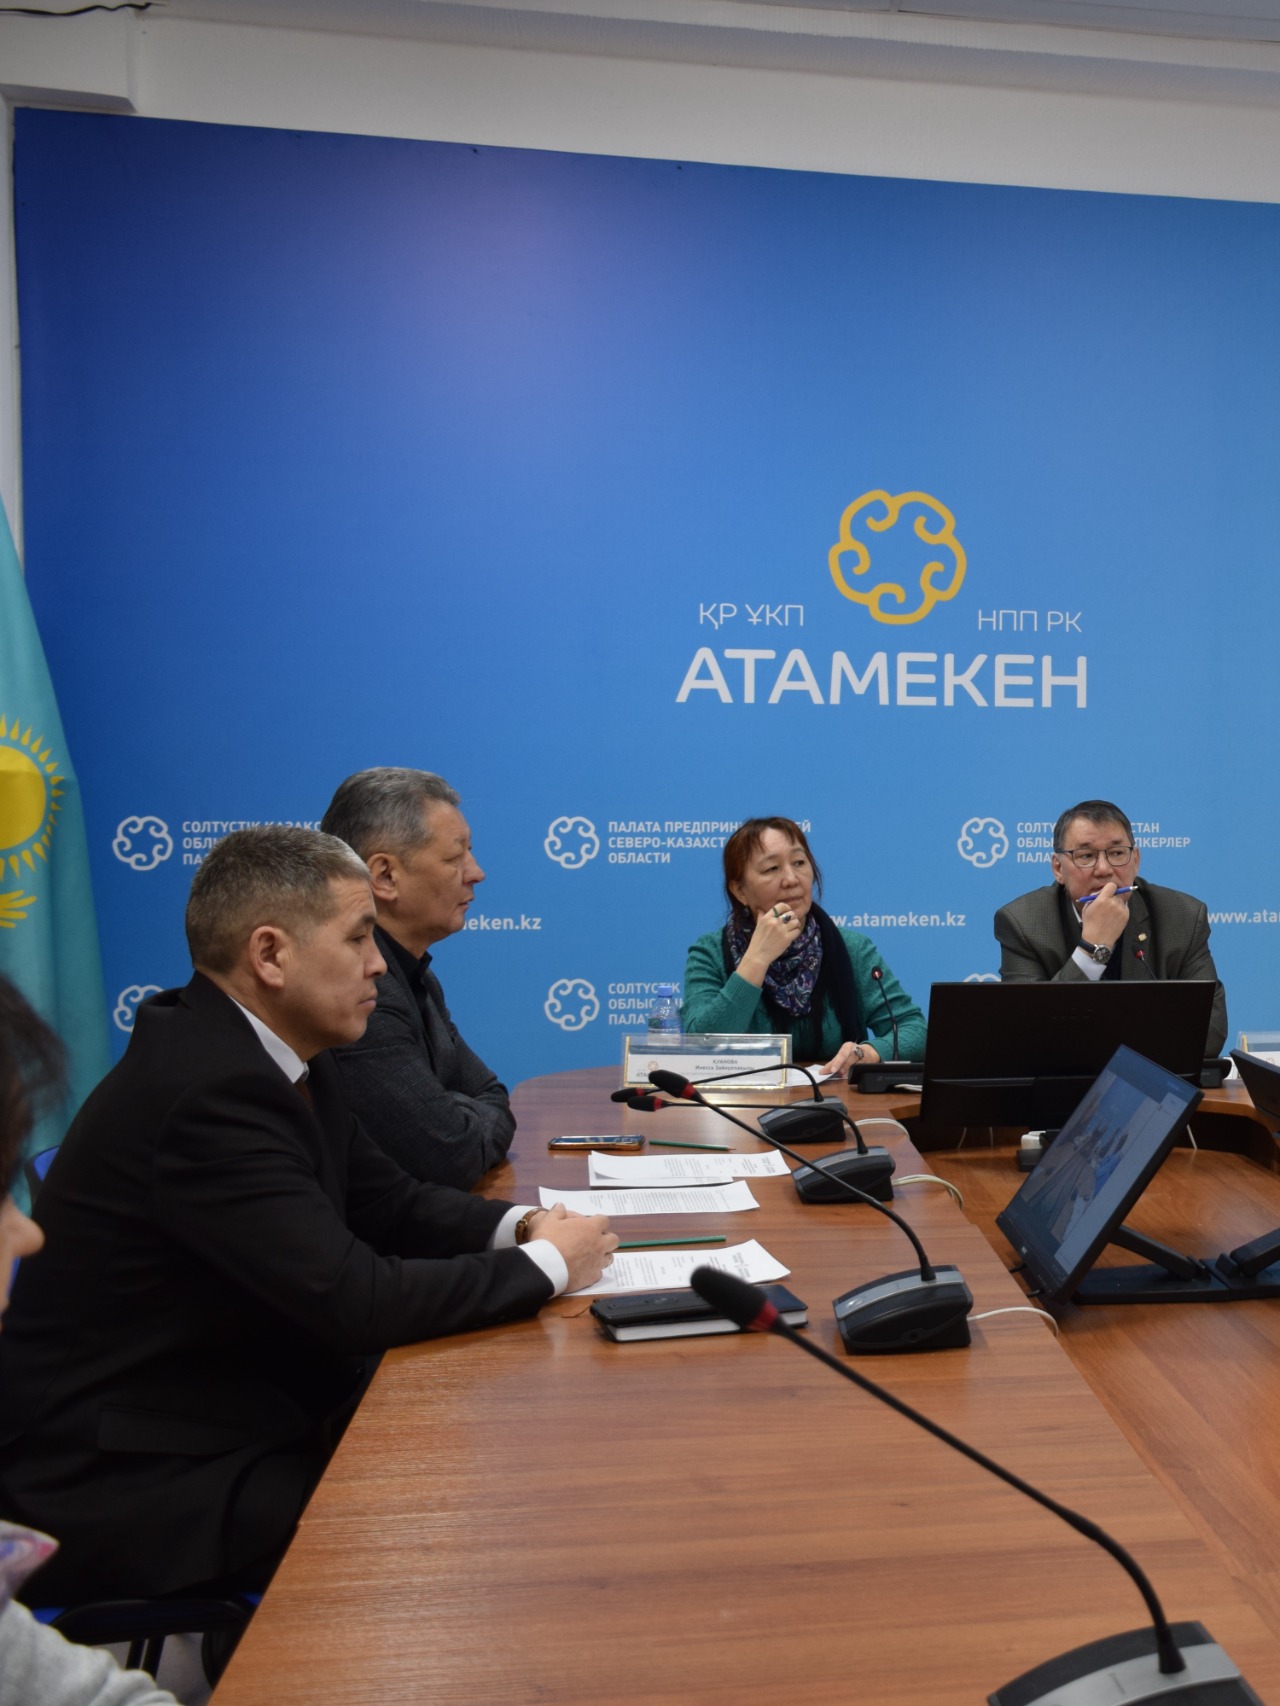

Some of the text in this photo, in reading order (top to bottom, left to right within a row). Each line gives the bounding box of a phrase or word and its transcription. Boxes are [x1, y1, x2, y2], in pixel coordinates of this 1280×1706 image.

[699, 602, 805, 630] ҚР ҰКП
[977, 609, 1083, 632] НПП РК
[675, 646, 1088, 709] АТАМЕКЕН
[608, 821, 661, 833] ПАЛАТА
[1130, 822, 1160, 833] СТАН
[608, 836, 727, 848] СЕВЕРО-КАЗАХСТ
[1016, 836, 1191, 848] ОБЛЫ ПКЕРЛЕР
[608, 852, 671, 864] ОБЛАСТИ
[1017, 851, 1055, 863] ПАЛА
[463, 913, 543, 930] eken.kz
[829, 911, 966, 927] w.atameken.kz
[608, 1013, 651, 1025] ПАЛА
